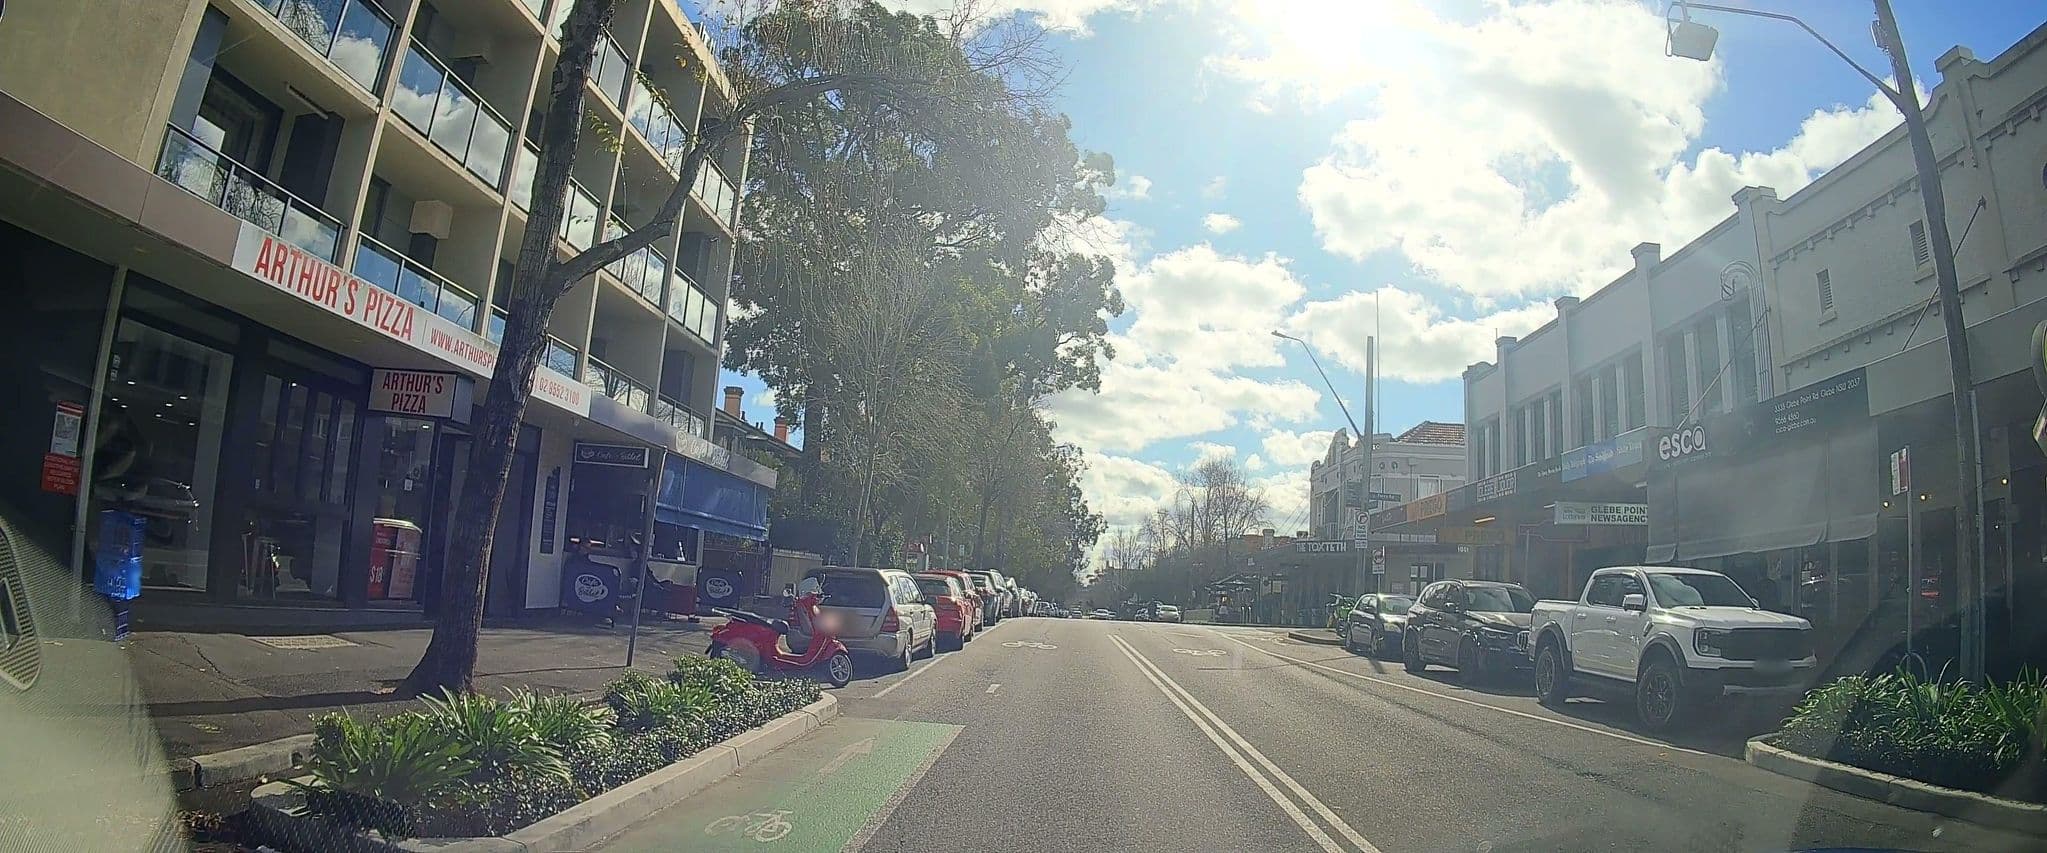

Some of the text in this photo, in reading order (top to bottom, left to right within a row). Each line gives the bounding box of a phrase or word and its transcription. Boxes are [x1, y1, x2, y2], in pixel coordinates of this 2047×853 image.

[254, 236, 416, 341] ARTHUR'S PIZZA
[430, 327, 496, 371] WWW.ARTHURSPI
[382, 372, 444, 395] ARTHUR'S
[1786, 398, 1800, 410] Glebe
[1800, 394, 1811, 407] Point
[1811, 392, 1819, 401] Rd
[1820, 387, 1835, 399] Glebe
[1847, 376, 1861, 390] 2037
[391, 392, 427, 414] PIZZA
[1659, 425, 1706, 460] esca
[1591, 505, 1621, 514] GLEBE
[1296, 541, 1347, 552] THE TOXTETH
